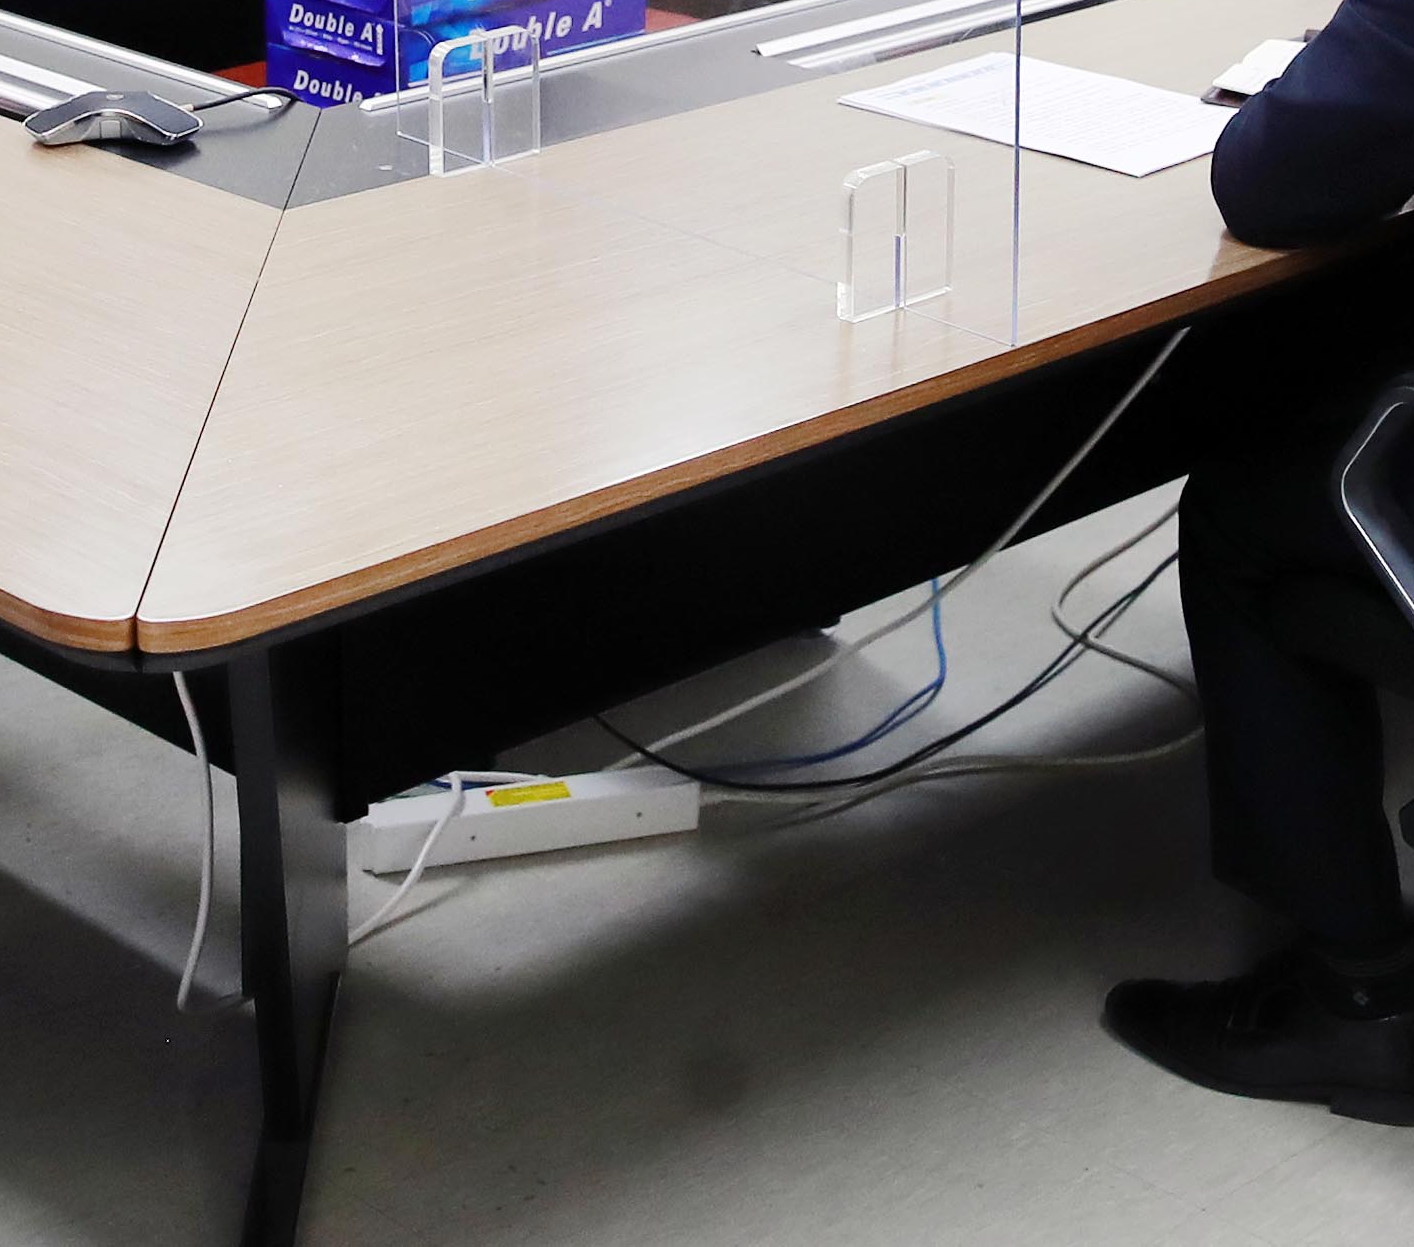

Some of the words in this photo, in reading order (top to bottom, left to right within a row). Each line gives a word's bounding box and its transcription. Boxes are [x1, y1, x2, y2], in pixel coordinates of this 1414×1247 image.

[289, 3, 355, 38] Double
[360, 22, 374, 43] A
[468, 11, 572, 62] Double
[294, 69, 364, 105] Double
